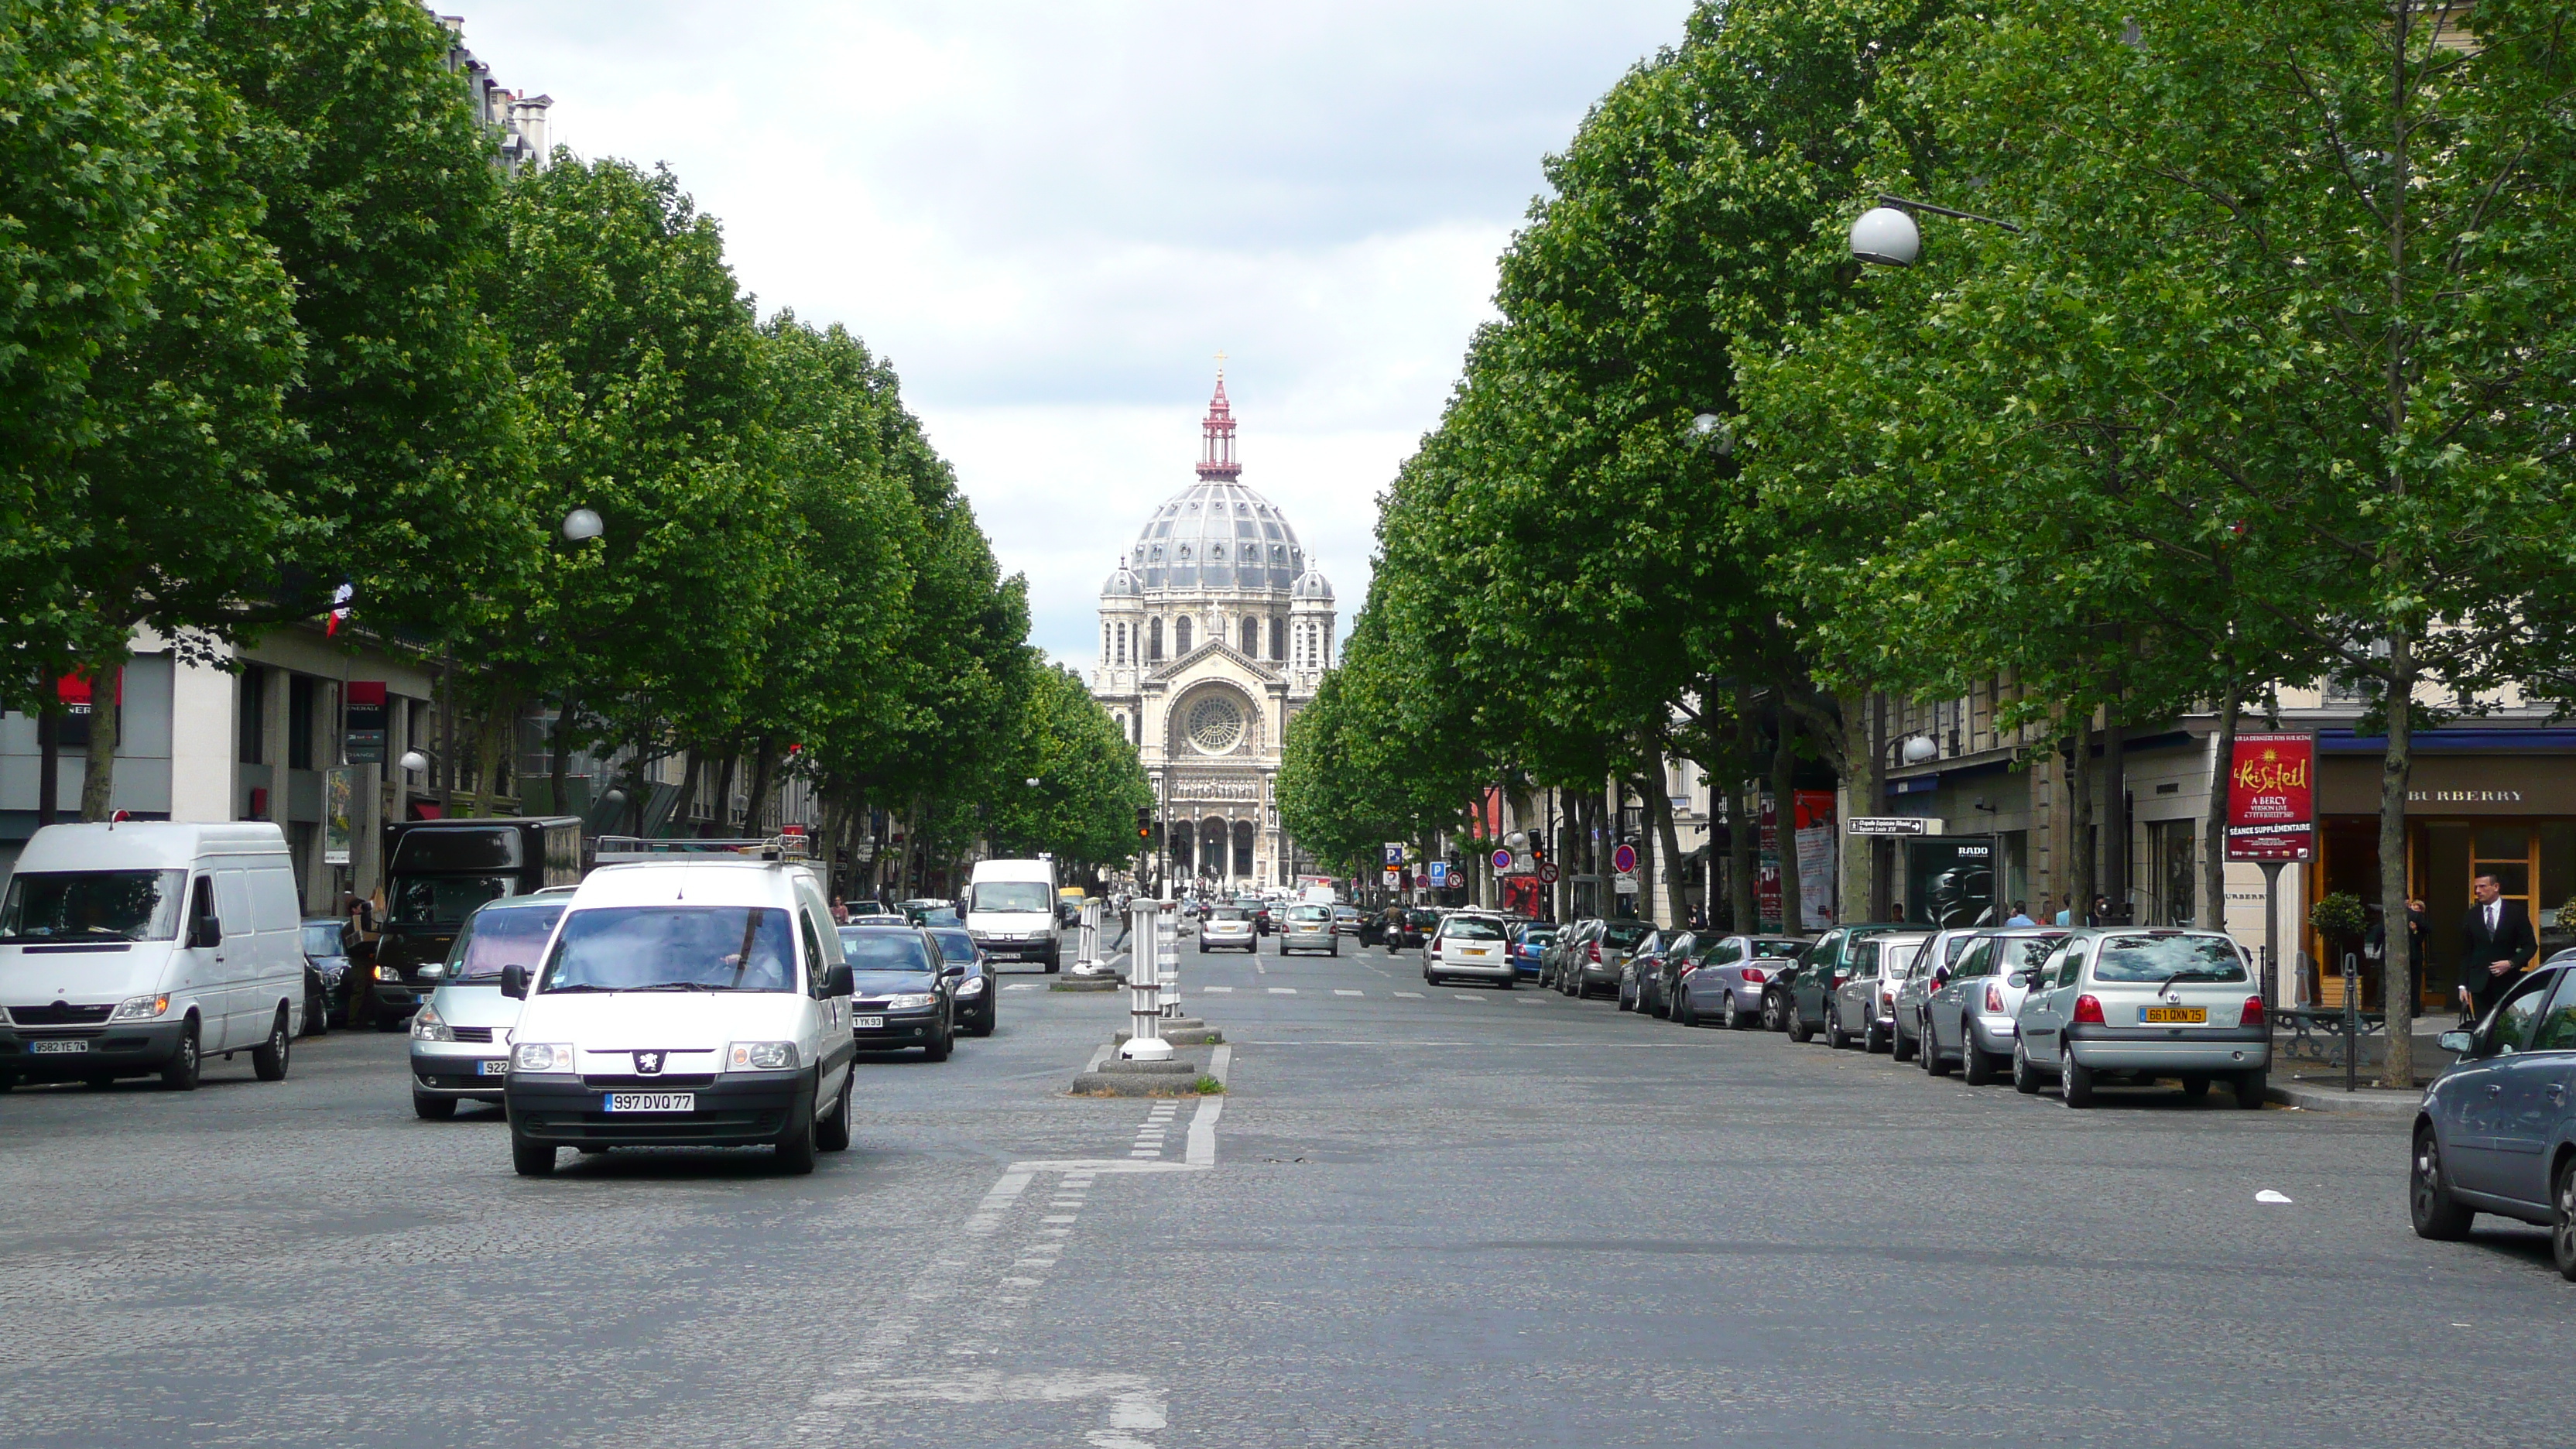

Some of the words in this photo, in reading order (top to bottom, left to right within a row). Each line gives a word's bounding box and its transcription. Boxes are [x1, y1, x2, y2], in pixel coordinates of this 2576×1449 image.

[2256, 759, 2307, 793] Soleil
[2259, 796, 2287, 805] BERCY
[2407, 790, 2524, 801] BURBERRY
[2229, 826, 2254, 835] SÉANCE
[2254, 823, 2311, 834] SUPPLÉMENTAIRE
[2150, 1009, 2167, 1020] 661
[2170, 1009, 2187, 1020] QXN
[2189, 1009, 2201, 1020] 75
[36, 1042, 59, 1052] 9582
[61, 1042, 72, 1051] YE
[74, 1042, 87, 1051] 76
[615, 1095, 641, 1110] 997
[644, 1095, 670, 1110] DVQ
[673, 1095, 691, 1109] 77
